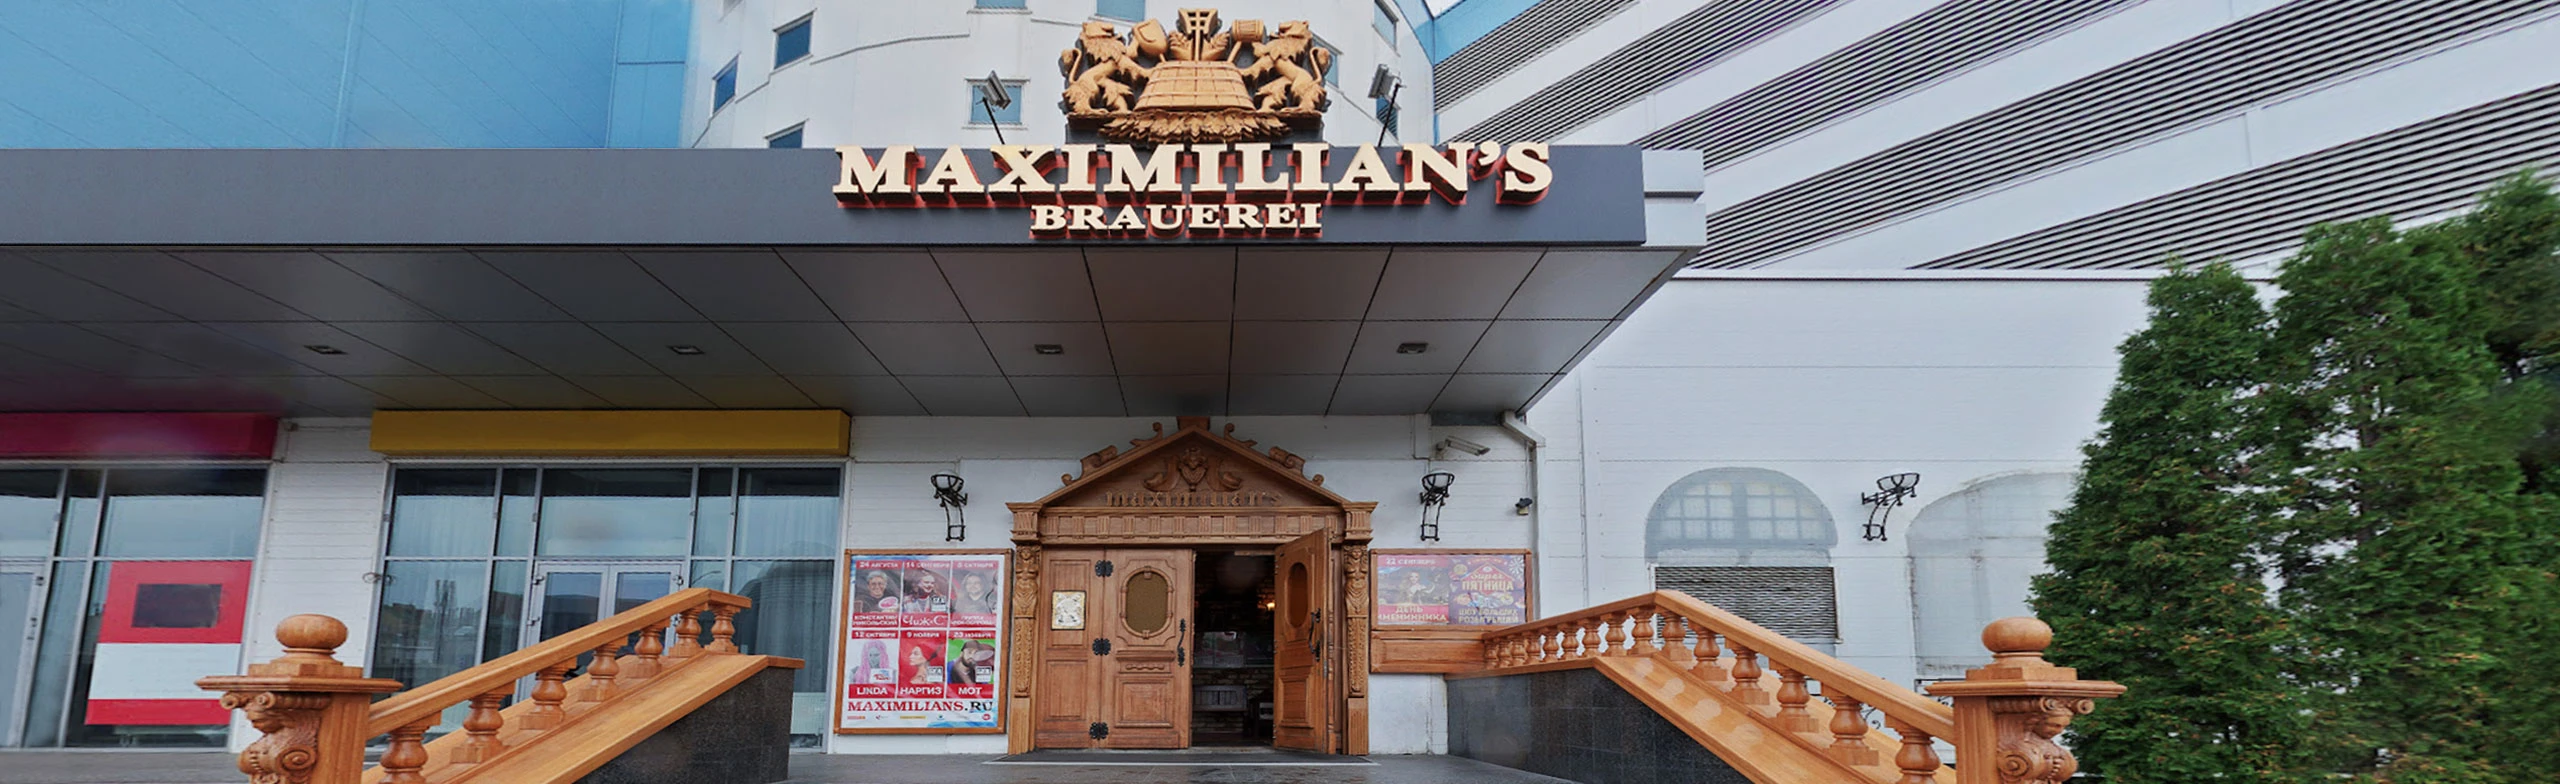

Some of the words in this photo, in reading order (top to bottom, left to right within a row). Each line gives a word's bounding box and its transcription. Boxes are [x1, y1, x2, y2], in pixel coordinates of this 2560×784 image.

[1031, 203, 1322, 232] BRAUEREI
[1462, 580, 1514, 591] ПЯТНИЦА
[1396, 605, 1424, 613] ДЕНЬ
[856, 687, 888, 695] LINDA
[900, 687, 942, 695] НАРГИЗ
[958, 687, 983, 695] МОТ
[847, 701, 993, 711] MAXIMILIANS.RU
